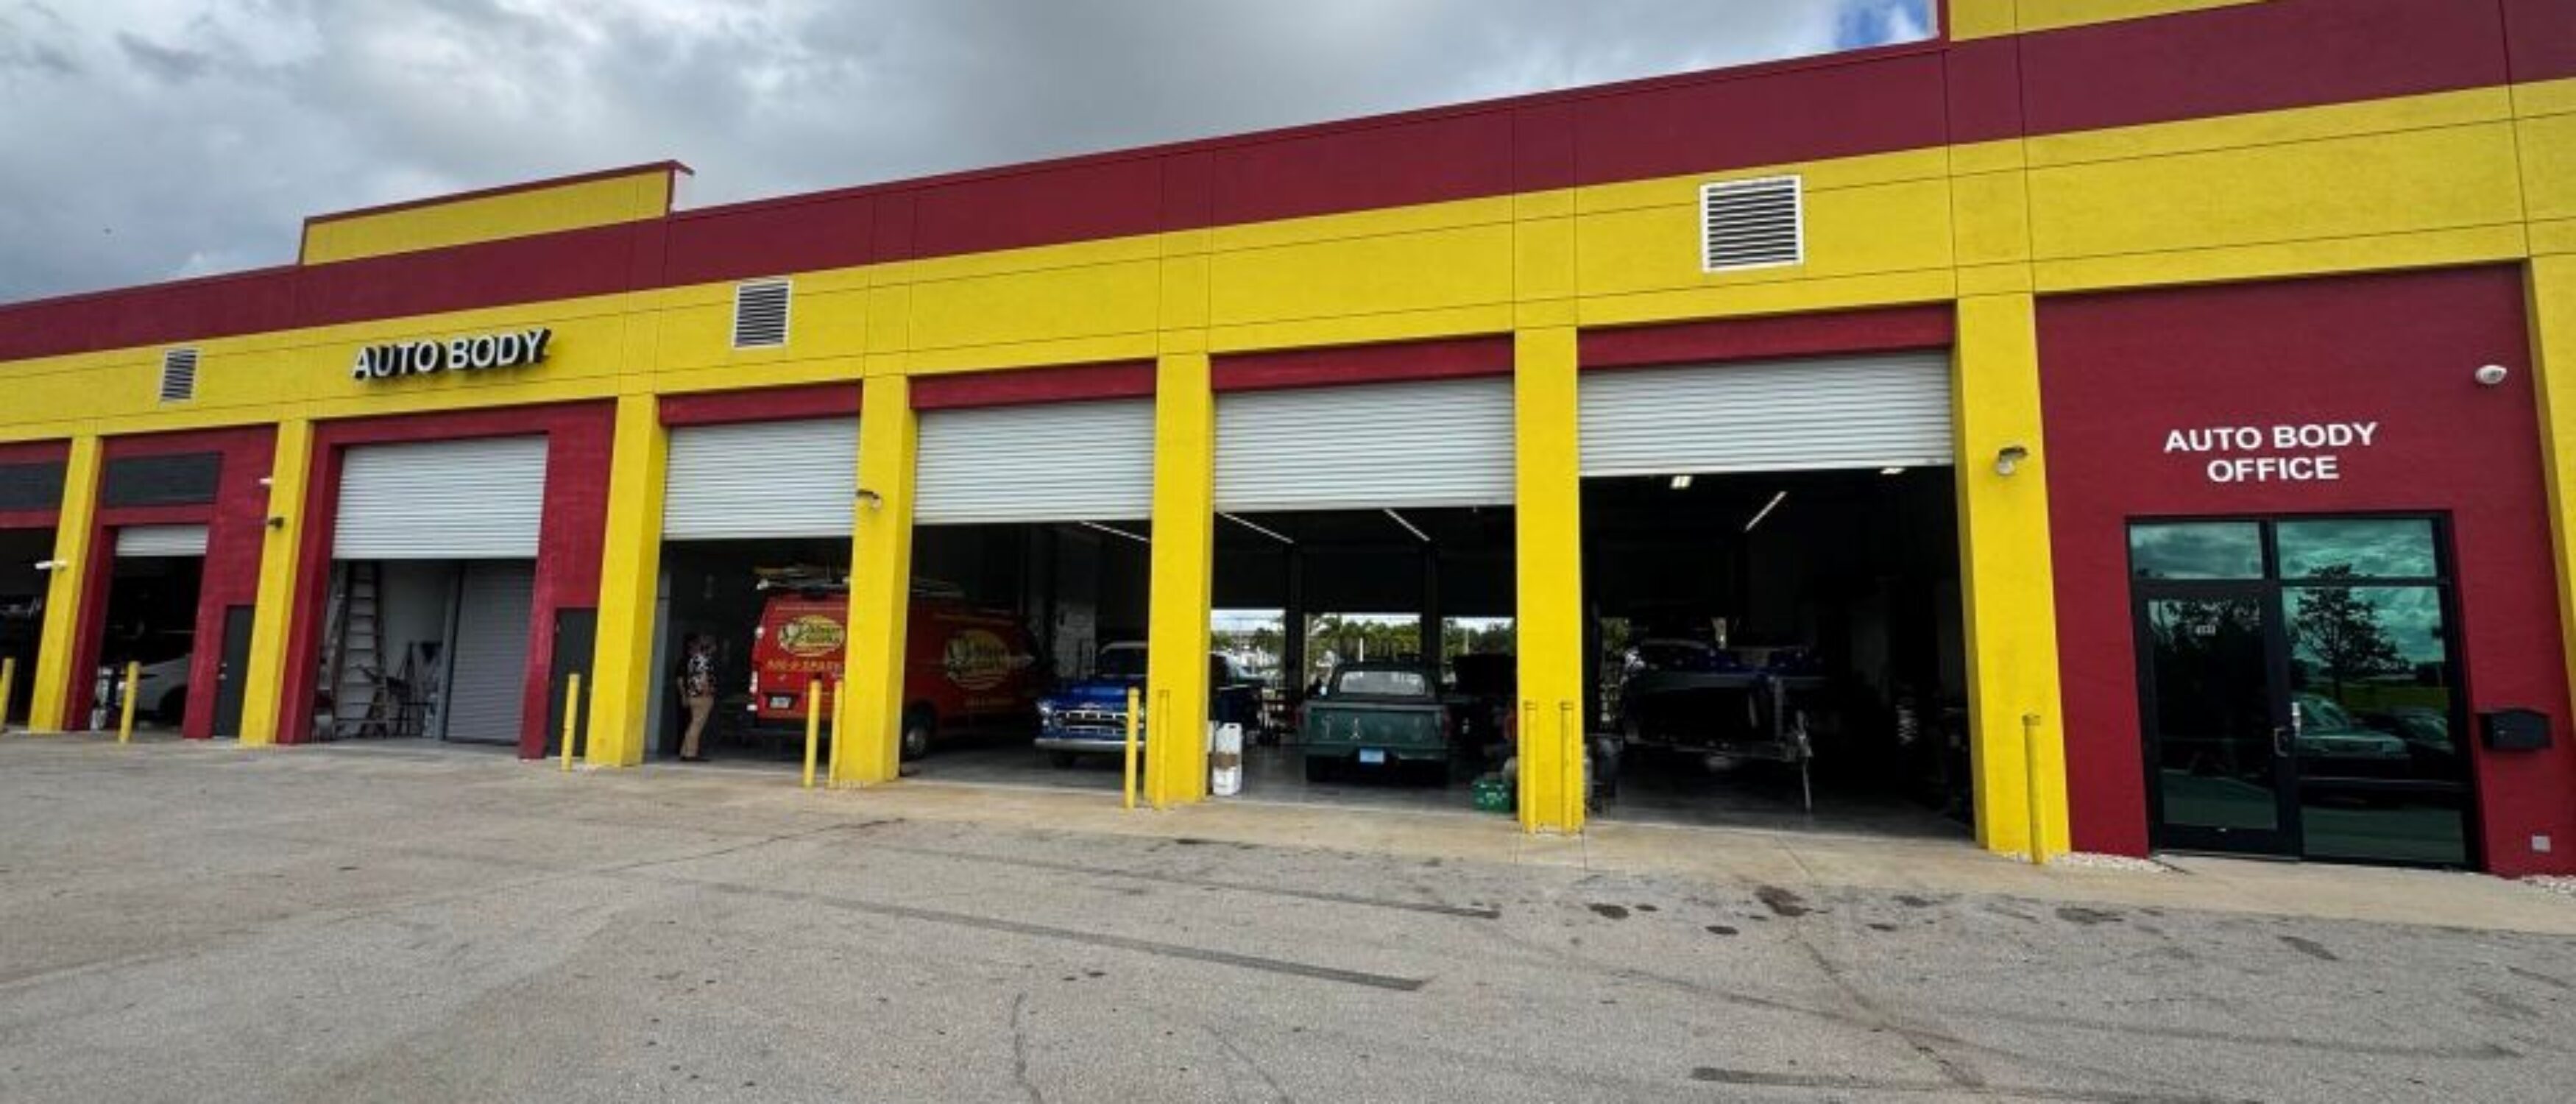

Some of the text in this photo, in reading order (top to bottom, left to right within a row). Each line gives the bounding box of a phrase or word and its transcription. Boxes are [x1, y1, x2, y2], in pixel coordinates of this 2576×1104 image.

[353, 328, 546, 378] AUTO BODY
[2164, 422, 2378, 453] AUTO BODY
[2207, 455, 2340, 482] OFFICE
